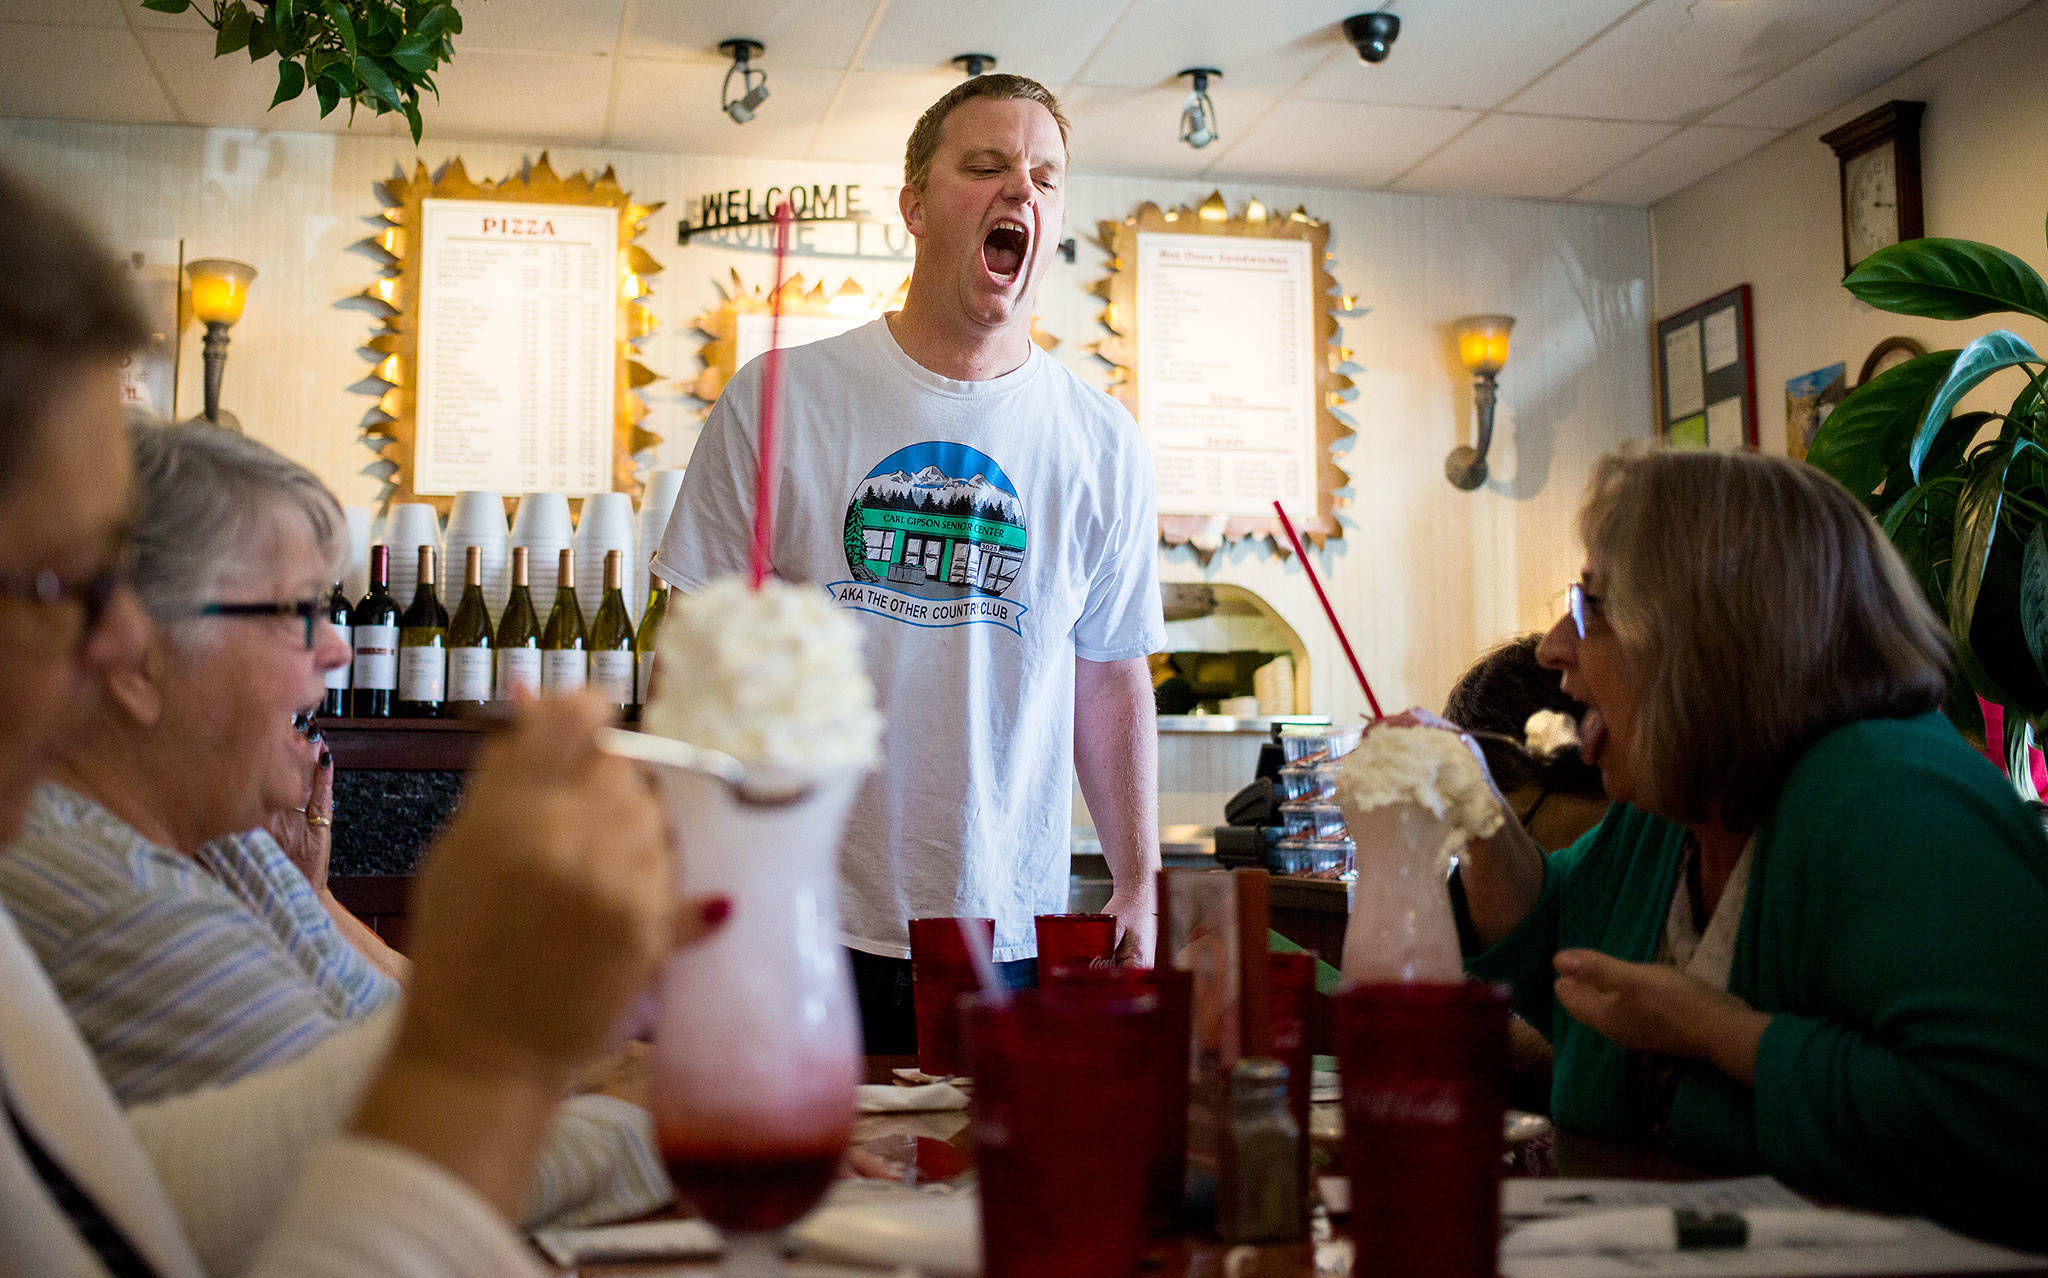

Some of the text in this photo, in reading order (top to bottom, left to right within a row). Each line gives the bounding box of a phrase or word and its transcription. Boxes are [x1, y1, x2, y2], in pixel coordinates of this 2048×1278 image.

[702, 184, 861, 227] WELCOME
[482, 217, 556, 236] PIZZA
[883, 513, 1005, 539] CARL GIPSON SENIOR CENTER
[980, 543, 998, 552] 3025
[838, 587, 864, 602] AKA
[867, 590, 889, 609] THE
[890, 598, 928, 619] OTHER
[980, 601, 1008, 621] CLUB
